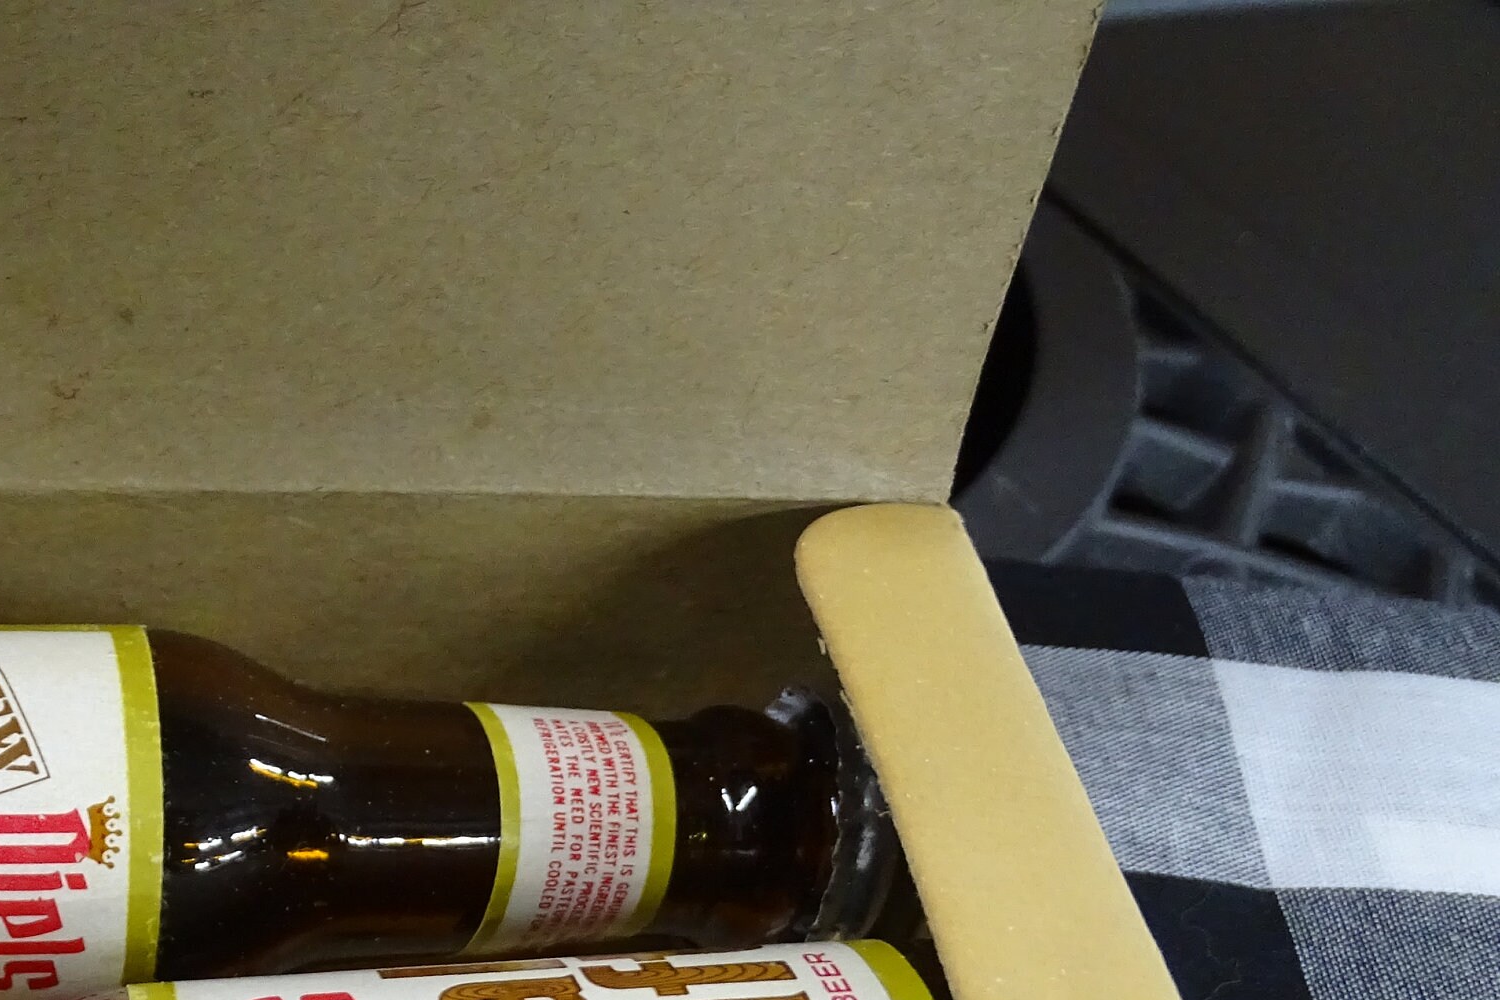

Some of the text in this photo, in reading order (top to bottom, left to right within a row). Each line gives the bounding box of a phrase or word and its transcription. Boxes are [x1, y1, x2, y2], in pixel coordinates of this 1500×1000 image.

[532, 718, 566, 805] REFRIGERATION
[572, 726, 597, 764] COSTLY
[565, 755, 583, 779] THE
[602, 758, 619, 789] WITH
[614, 740, 637, 786] CERTIFY
[586, 769, 601, 797] NEW
[570, 788, 585, 825] NEED
[606, 793, 622, 818] THE
[625, 791, 640, 823] THAT
[551, 812, 566, 854] UNTIL
[568, 835, 584, 862] FOR
[583, 802, 602, 875] SCIENTIFIC
[603, 822, 622, 868] FINEST
[622, 828, 639, 857] THIS
[537, 861, 562, 910] COOLED
[619, 864, 635, 877] IS
